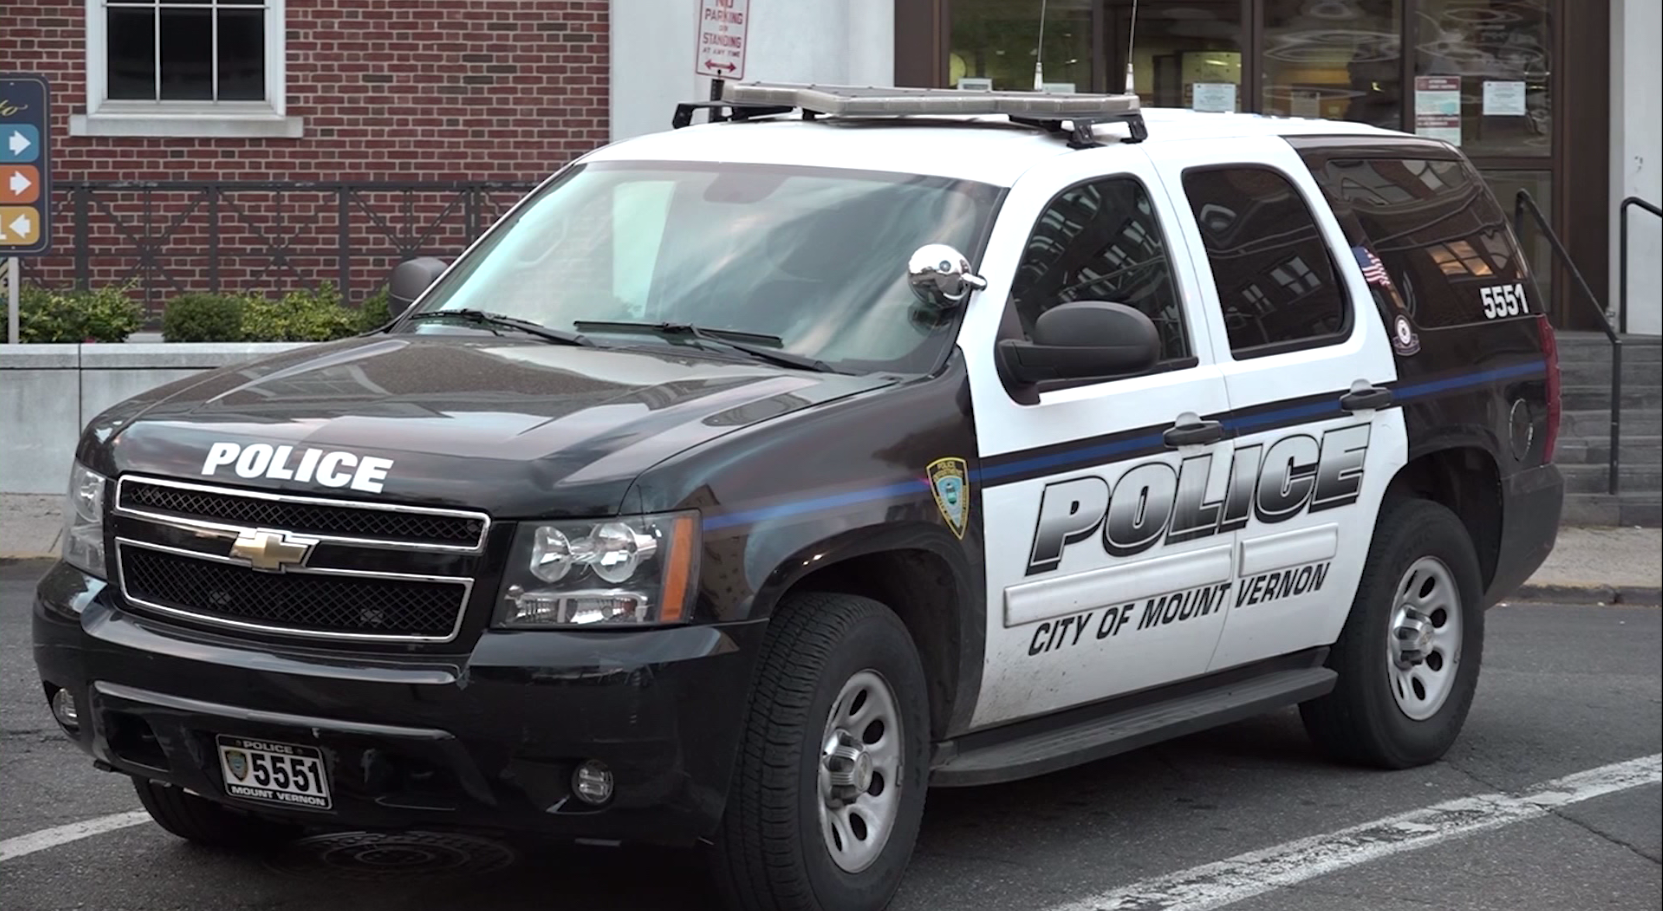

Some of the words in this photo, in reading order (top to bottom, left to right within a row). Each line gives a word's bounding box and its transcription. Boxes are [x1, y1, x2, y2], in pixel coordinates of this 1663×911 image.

[704, 8, 743, 25] PARKING
[702, 32, 742, 48] STANDING
[713, 48, 725, 56] ANY
[727, 50, 740, 58] TIME
[1480, 283, 1529, 319] 5551
[201, 442, 394, 493] POLICE
[1024, 422, 1372, 577] POLICE
[1028, 613, 1094, 656] CITY
[1096, 603, 1134, 640] OF
[1137, 582, 1232, 631] MOUNT
[1234, 562, 1331, 608] VERNON
[242, 740, 294, 754] POLICE
[250, 752, 324, 794] 5551
[231, 785, 274, 799] MOUNT
[276, 791, 326, 806] VERNON
